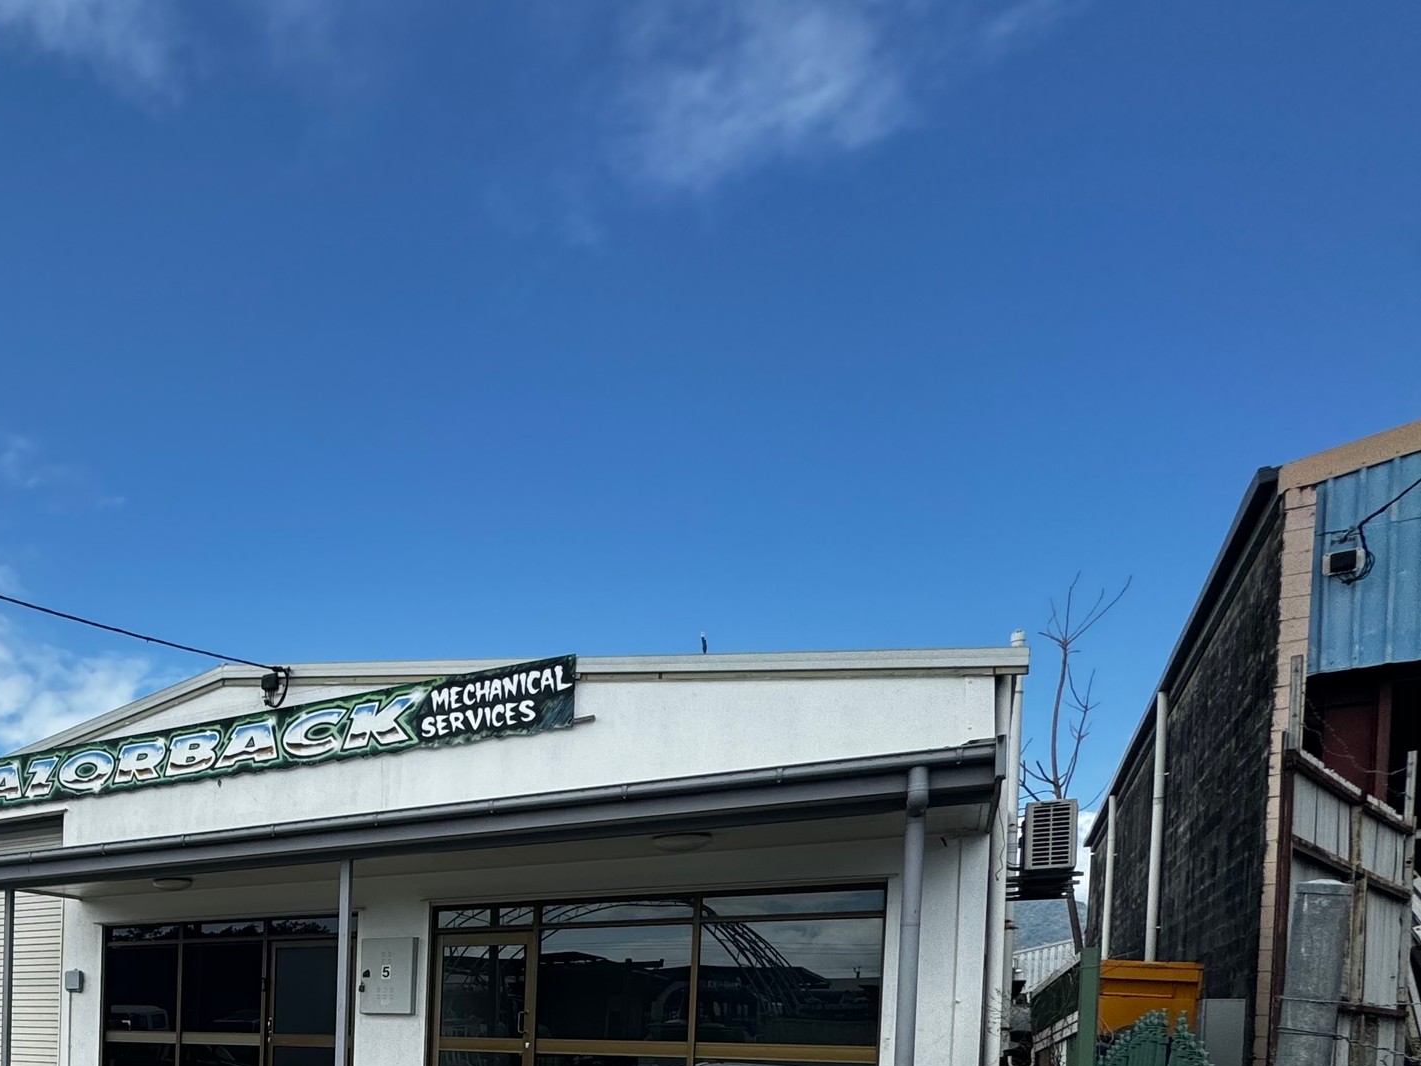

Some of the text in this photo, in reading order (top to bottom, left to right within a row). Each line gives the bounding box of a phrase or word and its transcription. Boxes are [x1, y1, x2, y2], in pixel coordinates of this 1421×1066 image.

[431, 665, 573, 713] MECHANICAL
[421, 700, 536, 738] SERVICES
[382, 966, 390, 978] 5
